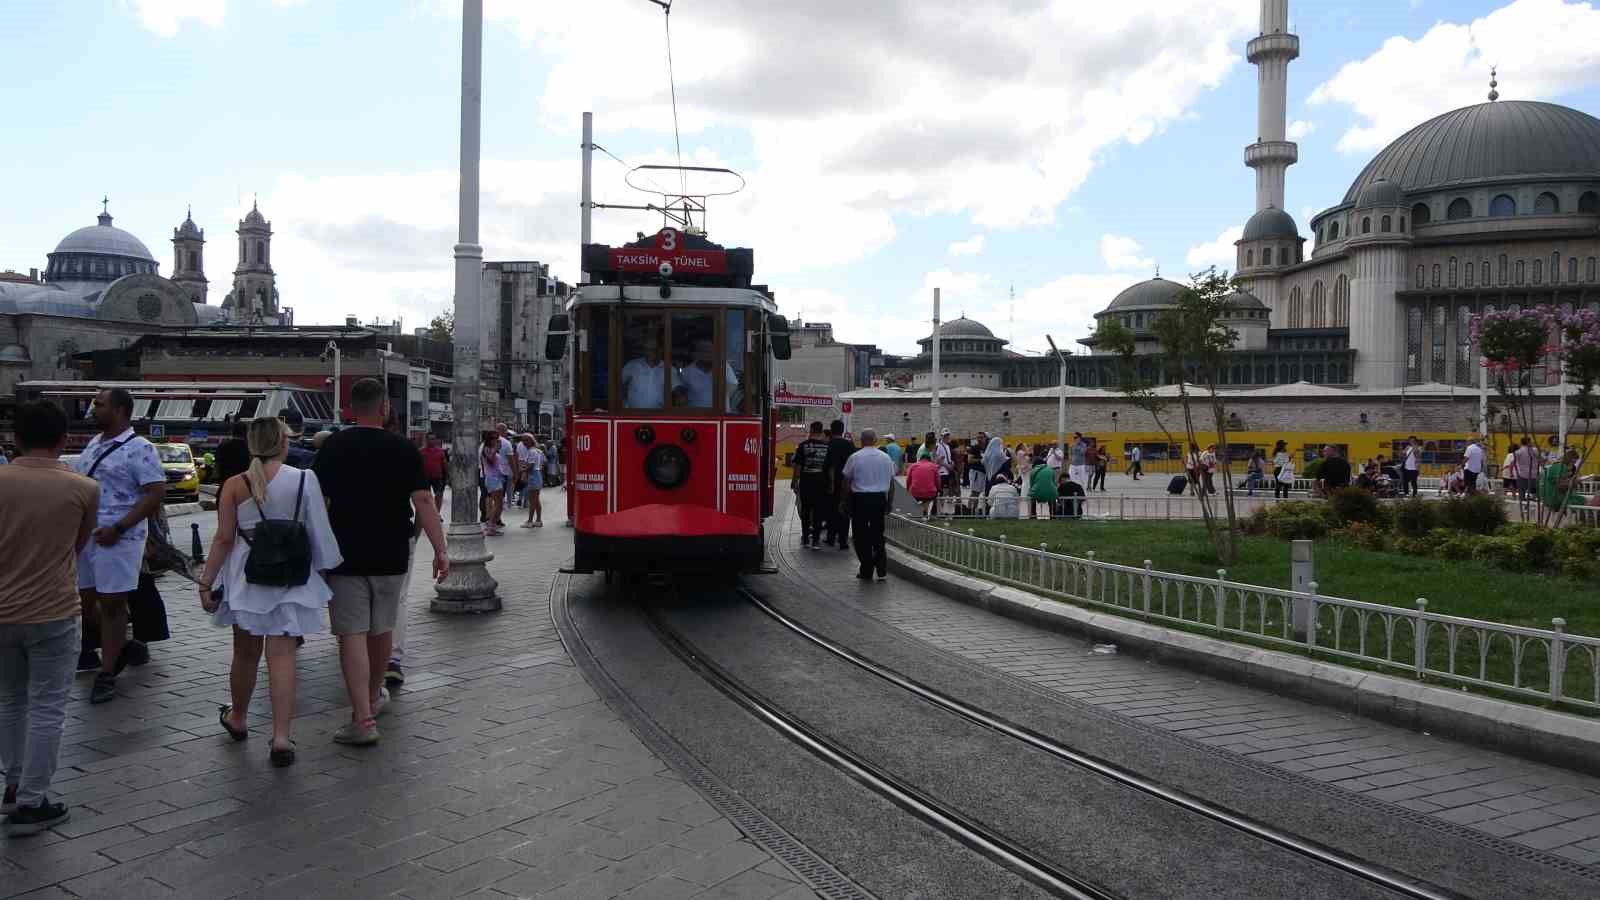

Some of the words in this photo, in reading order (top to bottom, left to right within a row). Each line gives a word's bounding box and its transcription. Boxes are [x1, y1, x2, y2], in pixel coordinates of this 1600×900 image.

[661, 229, 676, 251] 3
[617, 253, 658, 265] TAKSİM
[674, 255, 711, 268] TÜNEL
